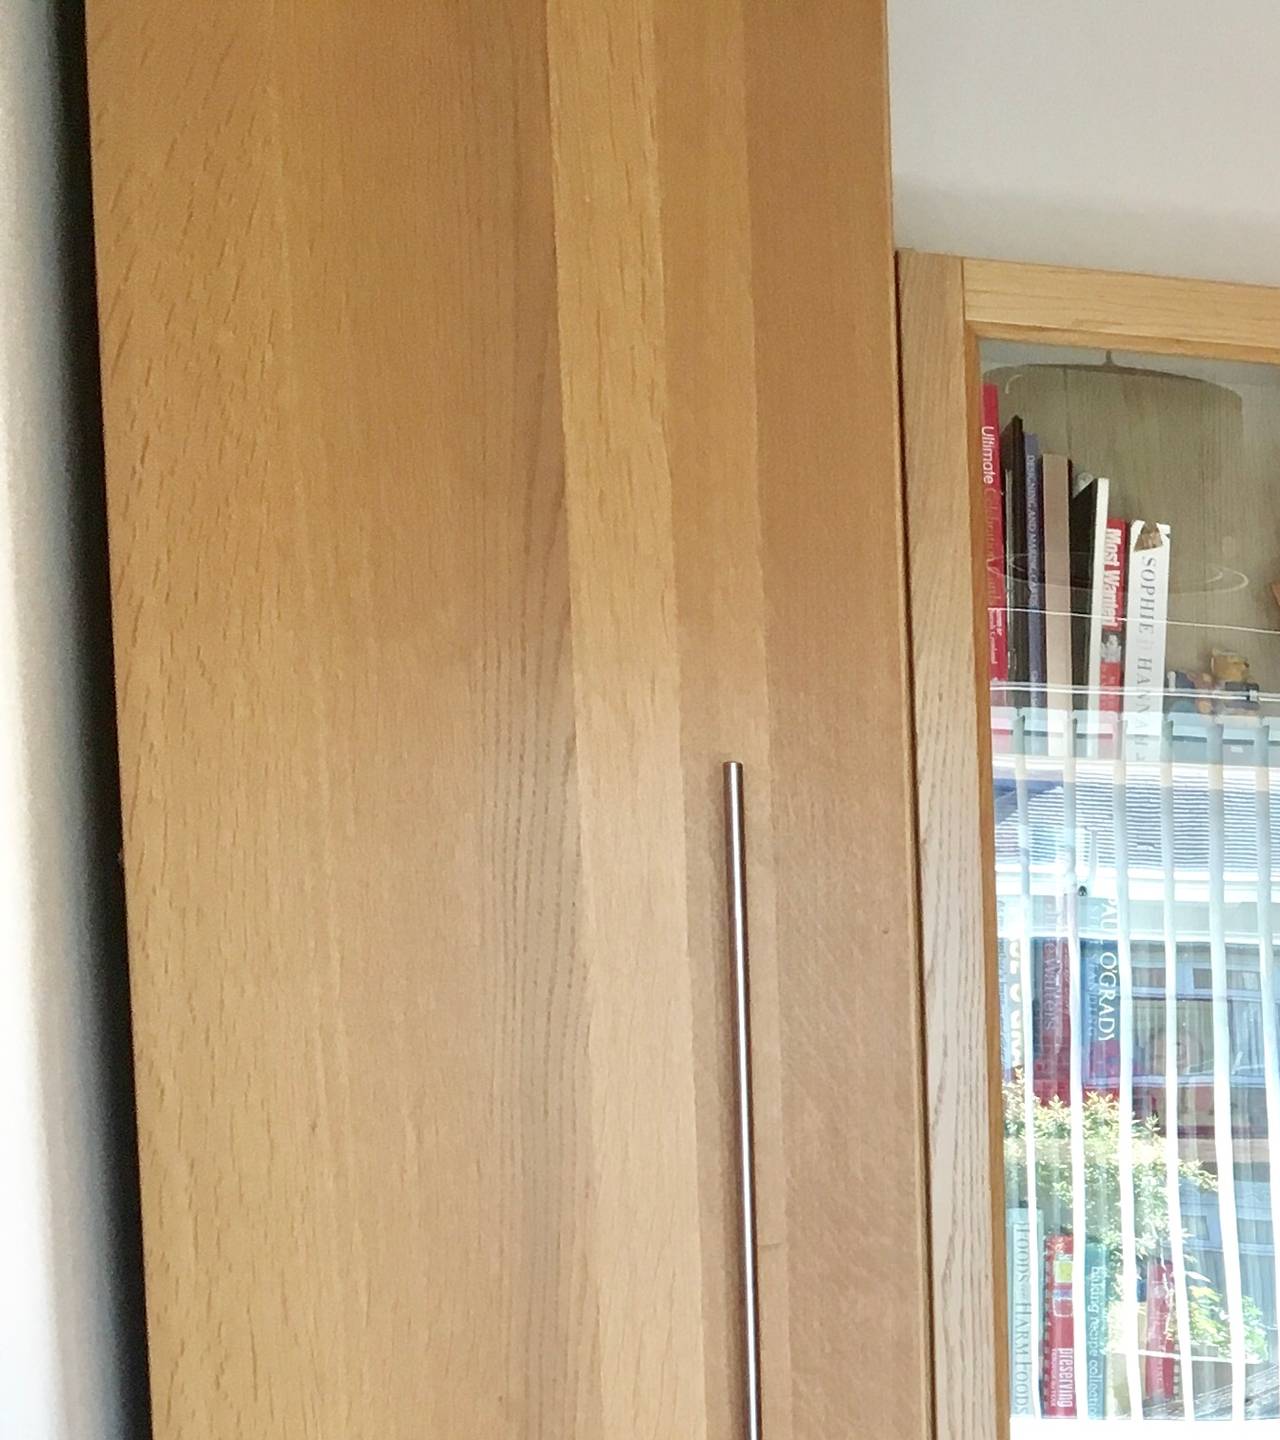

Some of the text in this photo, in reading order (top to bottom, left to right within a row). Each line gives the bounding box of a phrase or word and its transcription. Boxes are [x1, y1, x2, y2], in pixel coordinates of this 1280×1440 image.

[981, 425, 995, 485] Ultimate
[1102, 528, 1122, 628] Most Wanted
[1139, 556, 1156, 634] SOPHIE
[1015, 1228, 1030, 1282] FOODS
[1087, 1265, 1105, 1313] baking
[1015, 1302, 1031, 1356] HARM
[1087, 1316, 1103, 1357] recipe
[1015, 1356, 1032, 1416] FOODS
[1055, 1347, 1073, 1408] preserving
